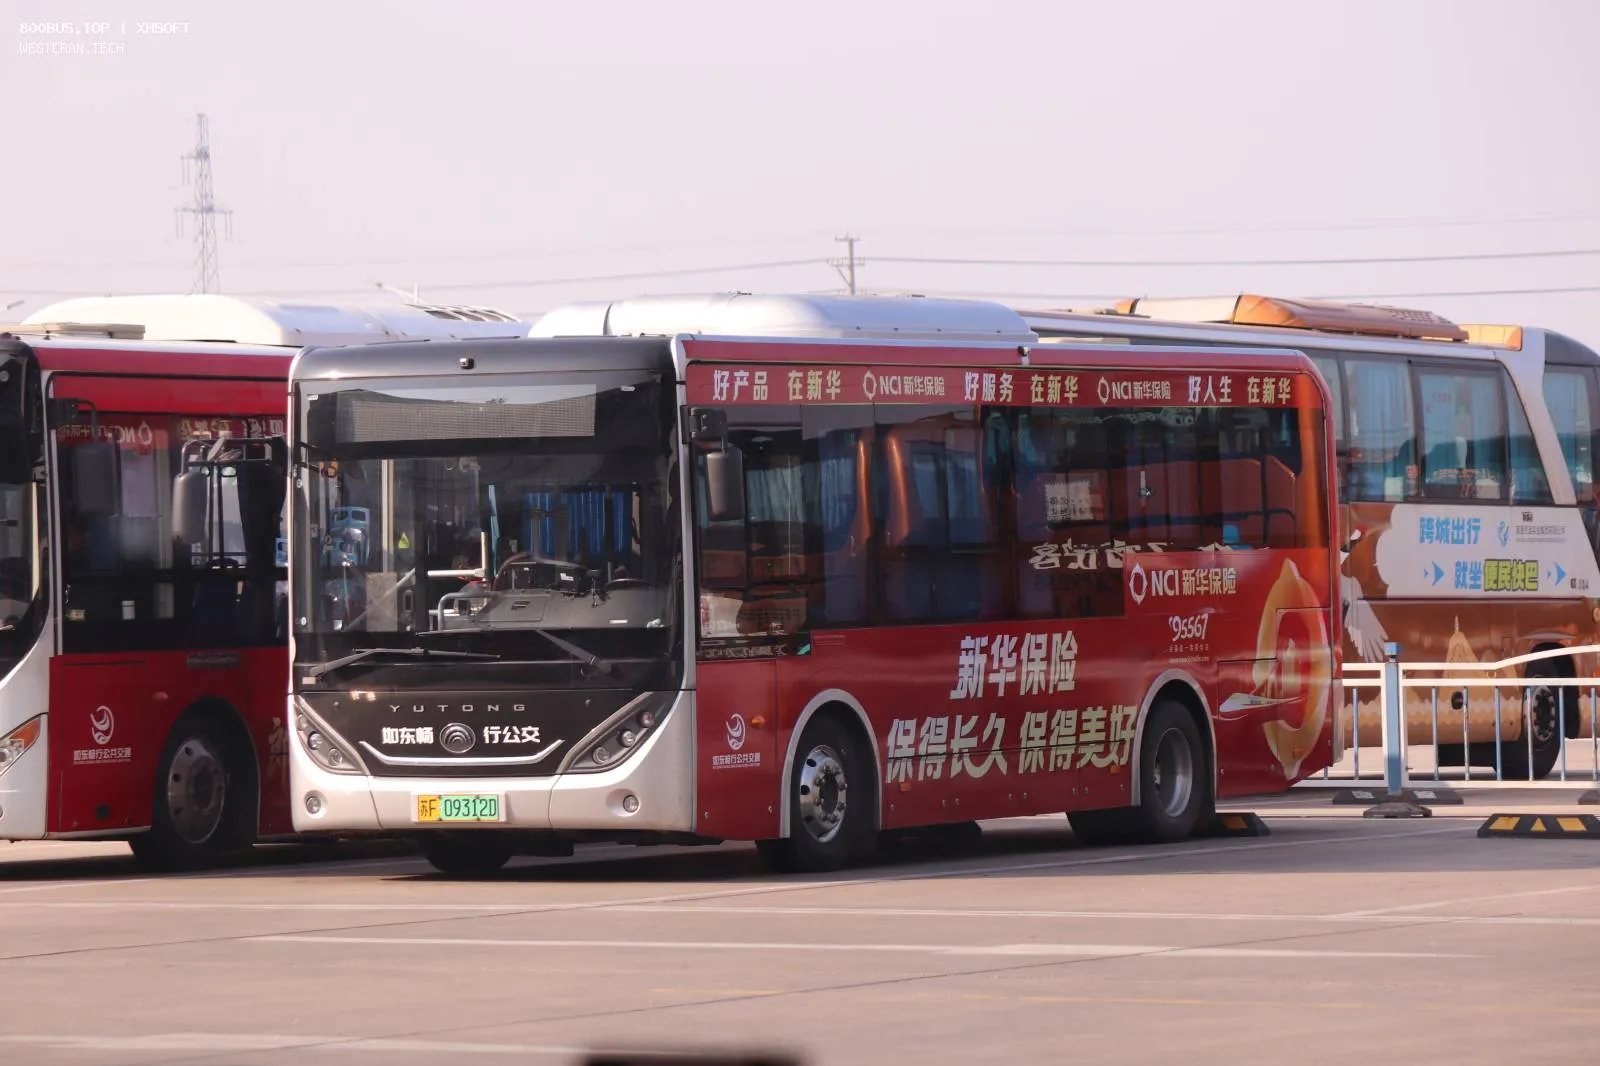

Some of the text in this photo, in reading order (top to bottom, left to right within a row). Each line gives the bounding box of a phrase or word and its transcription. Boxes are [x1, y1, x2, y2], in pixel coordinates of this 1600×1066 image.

[712, 370, 768, 401] 好产品
[788, 370, 841, 400] 在新华
[964, 371, 1014, 402] 好服务
[1031, 375, 1079, 404] 在新华
[1188, 376, 1232, 404] 好人生
[1247, 376, 1291, 404] 在新华
[1419, 516, 1481, 545] 跨城出行
[1169, 612, 1209, 641] 95567
[950, 630, 1078, 700] 新华保险
[389, 704, 526, 713] YUTONG
[483, 726, 541, 744] 行公交
[885, 704, 1138, 784] 保得长久 保得美好
